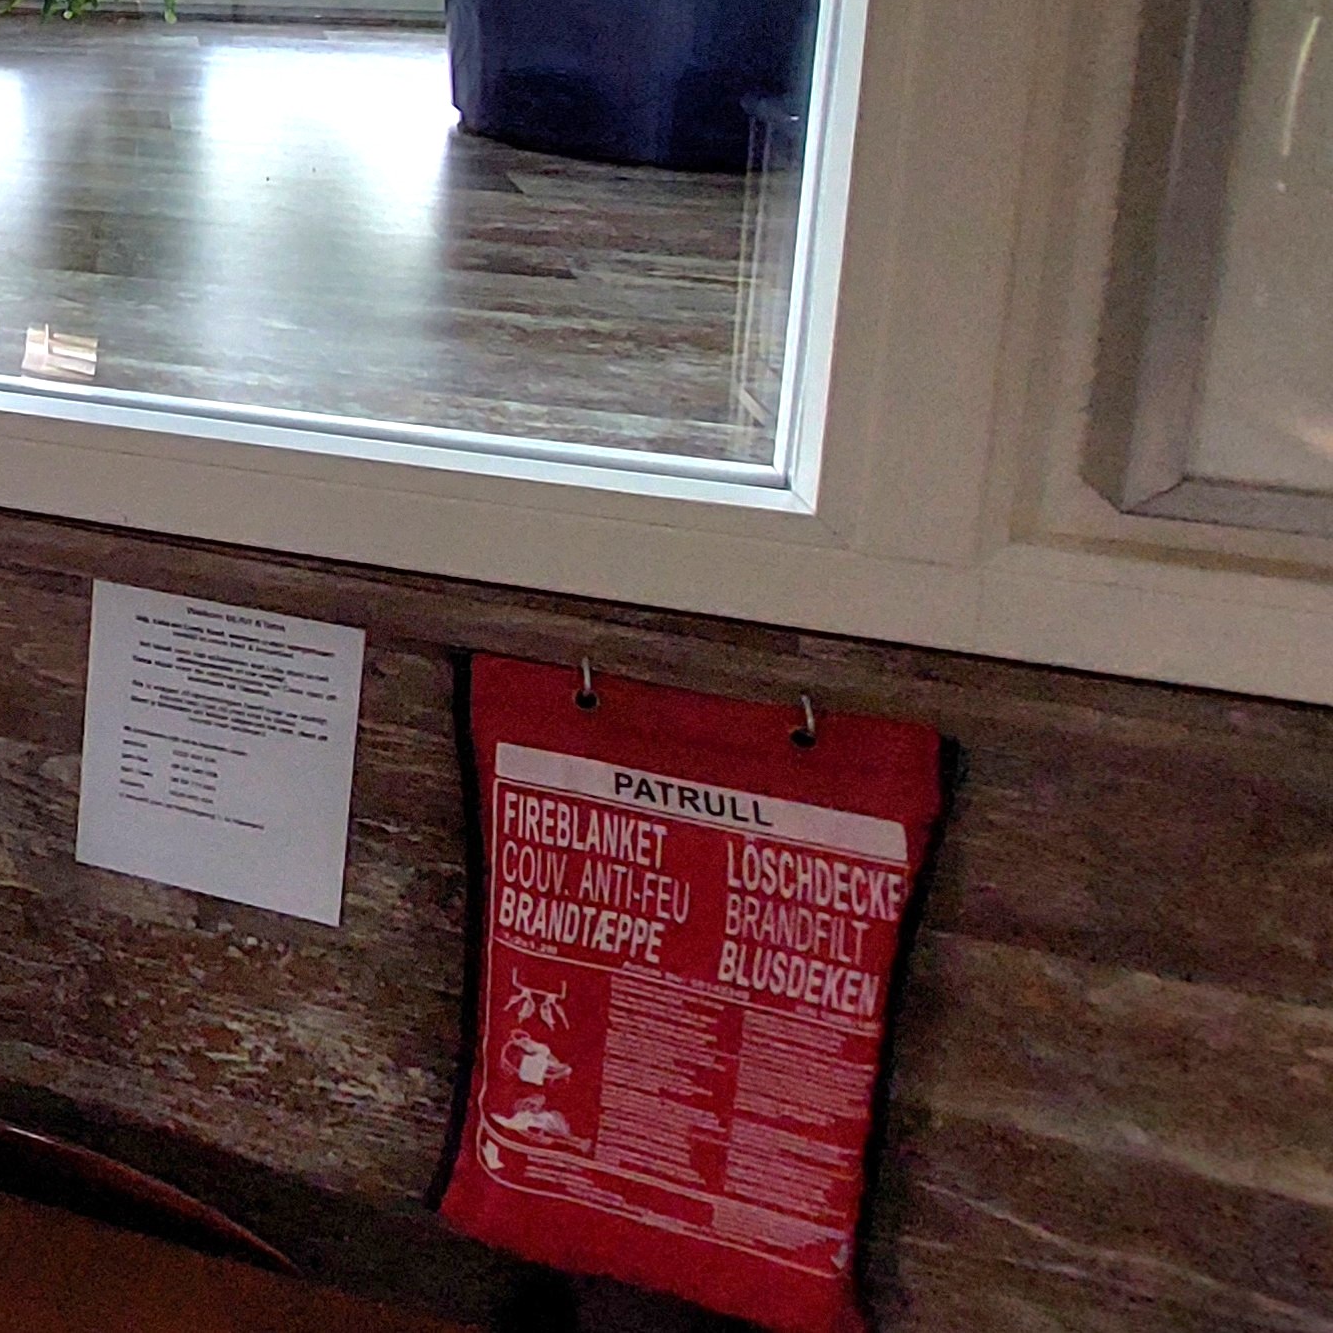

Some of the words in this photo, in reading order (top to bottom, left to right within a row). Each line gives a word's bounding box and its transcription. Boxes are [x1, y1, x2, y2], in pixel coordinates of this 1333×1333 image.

[504, 792, 667, 868] FIREBLANKET
[615, 773, 772, 826] PATRULL
[503, 841, 569, 898] COUV.
[579, 864, 690, 923] ANTI-FEU
[499, 891, 665, 963] BRANDTÆPPE
[726, 894, 871, 965] BRANDFILT
[718, 940, 880, 1016] BLUSDEKEN
